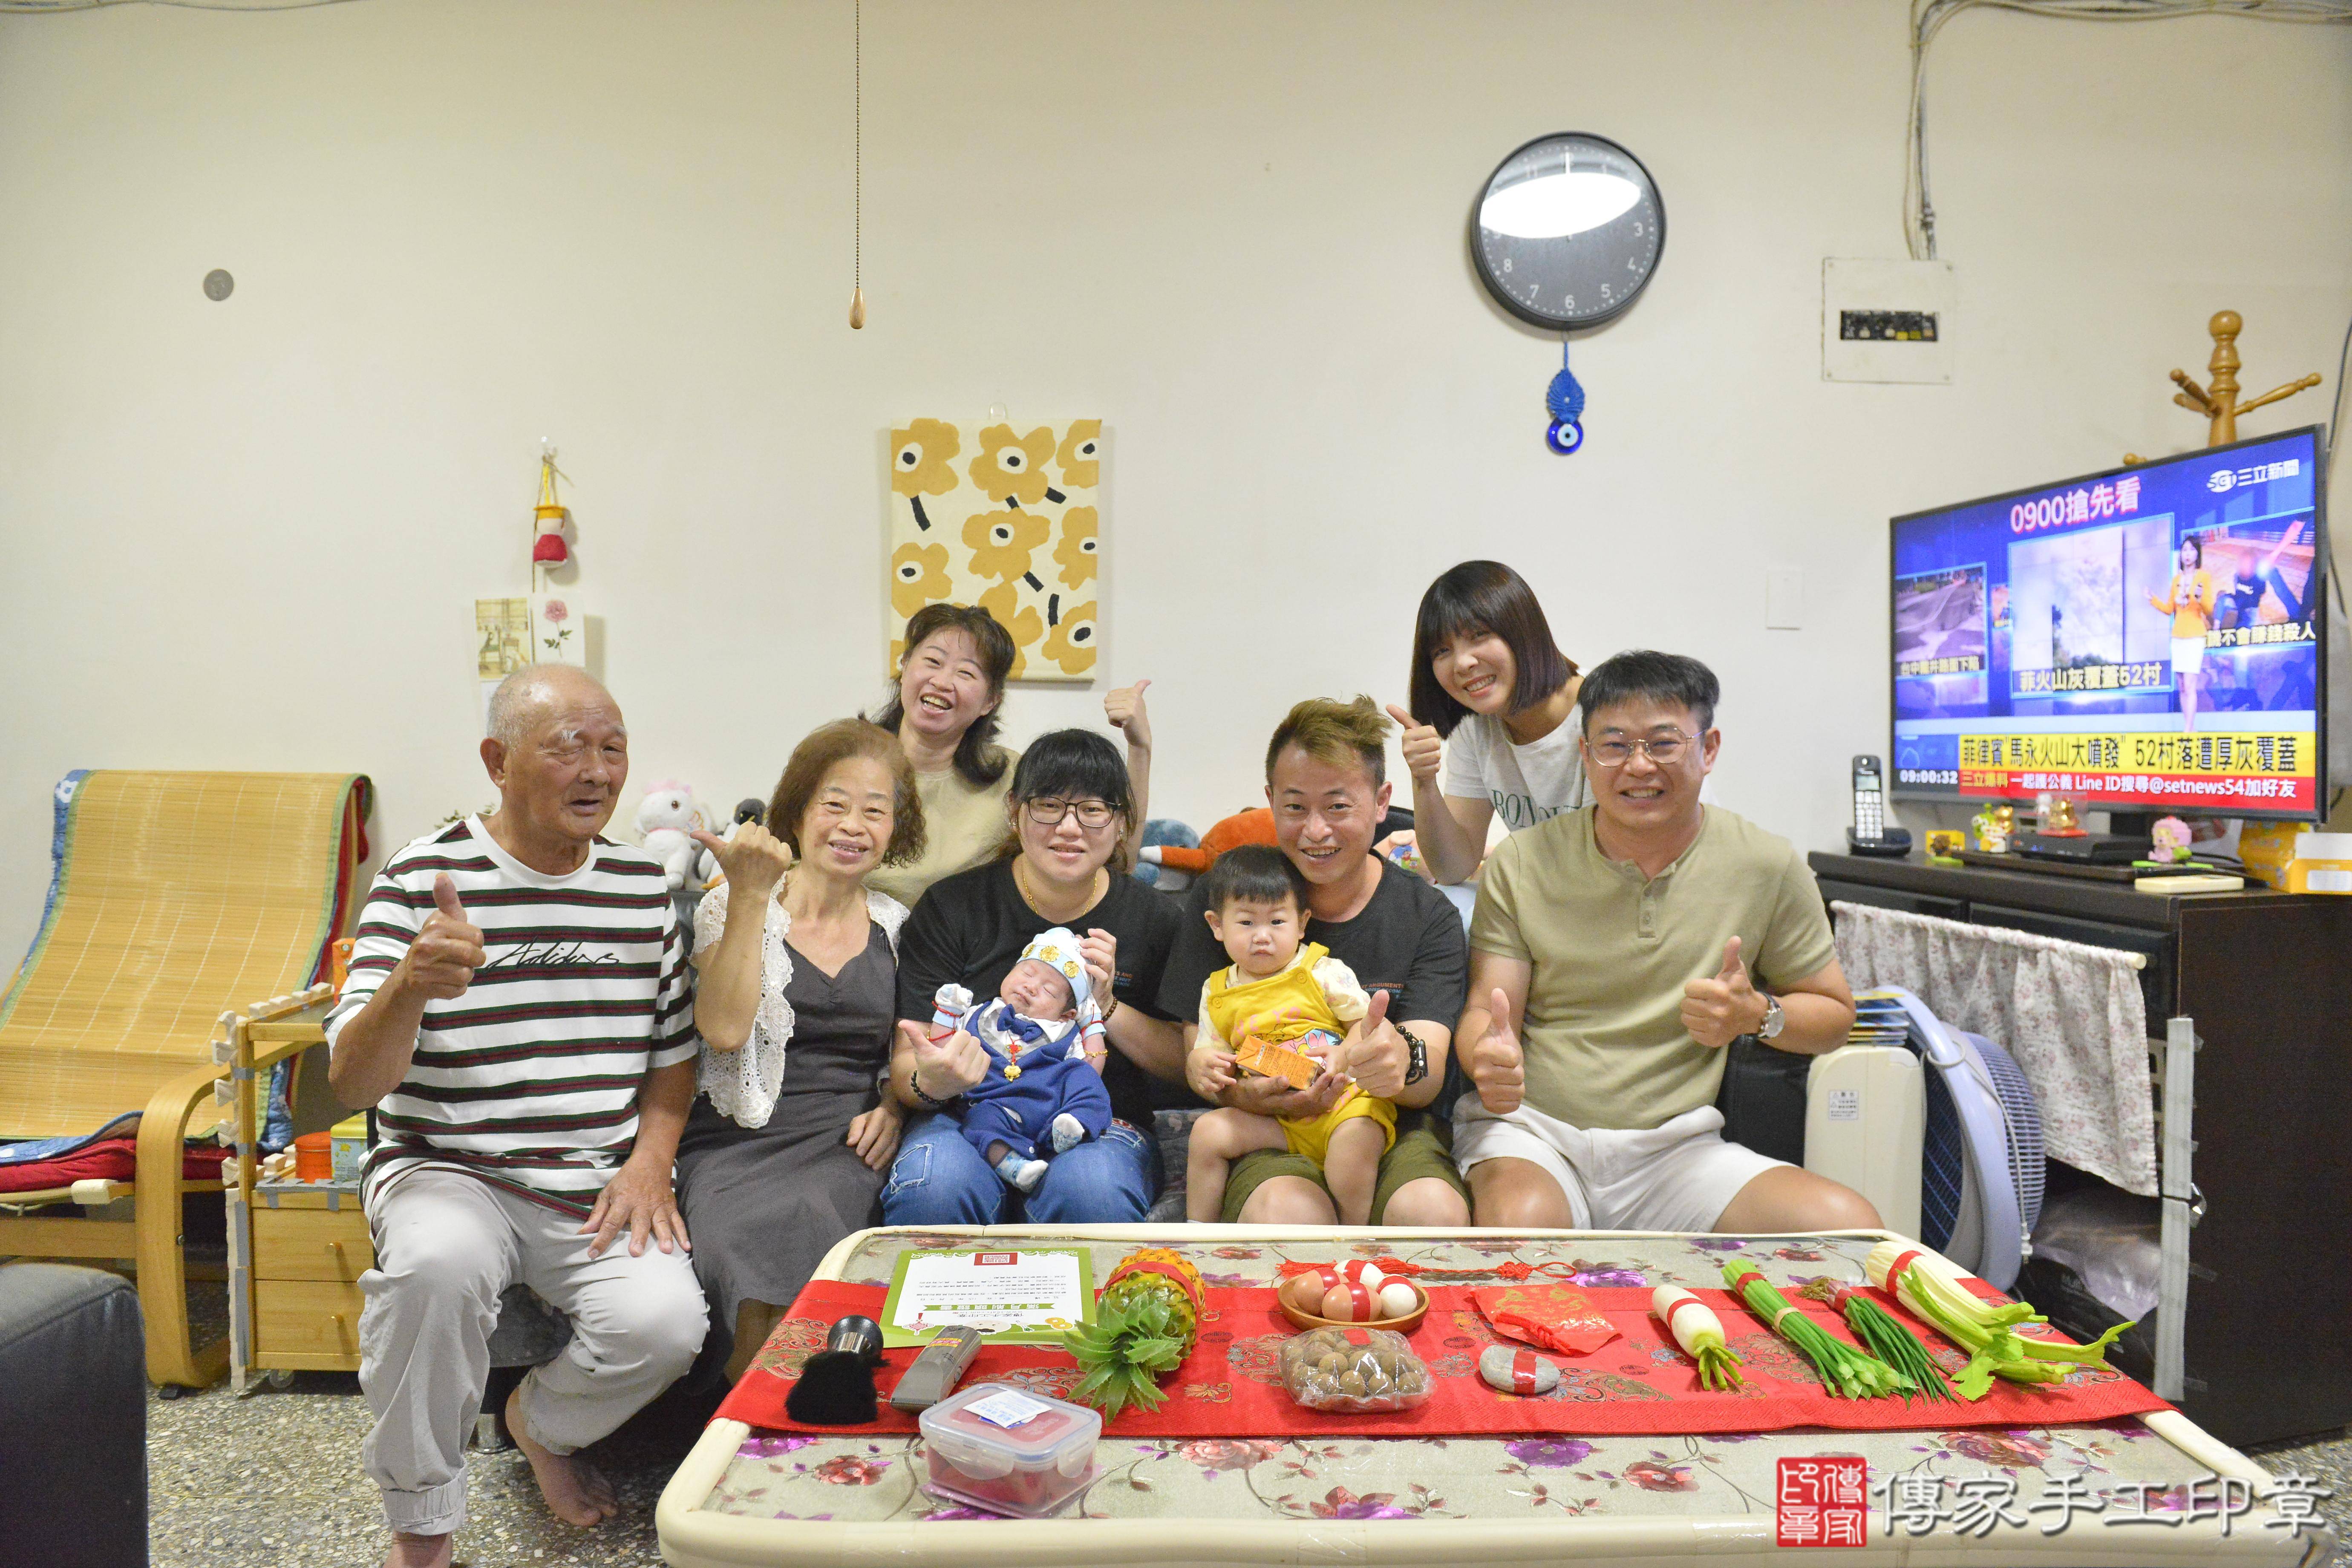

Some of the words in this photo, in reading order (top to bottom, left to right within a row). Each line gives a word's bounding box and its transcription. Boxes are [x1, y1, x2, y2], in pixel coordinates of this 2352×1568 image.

[1634, 222, 1643, 237] 3
[1503, 258, 1513, 273] 8
[1628, 257, 1636, 270] 4
[1530, 284, 1539, 298] 7
[1601, 284, 1611, 299] 5
[1565, 294, 1575, 310] 6
[2237, 458, 2300, 487] 三立新聞
[2010, 476, 2141, 534] 0900搶先看
[2020, 661, 2162, 692] 菲火山灰覆蓋52村
[2135, 736, 2297, 772] 52村落遭厚灰覆蓋
[1899, 770, 1958, 784] 09:00:32
[2075, 775, 2103, 790] Line
